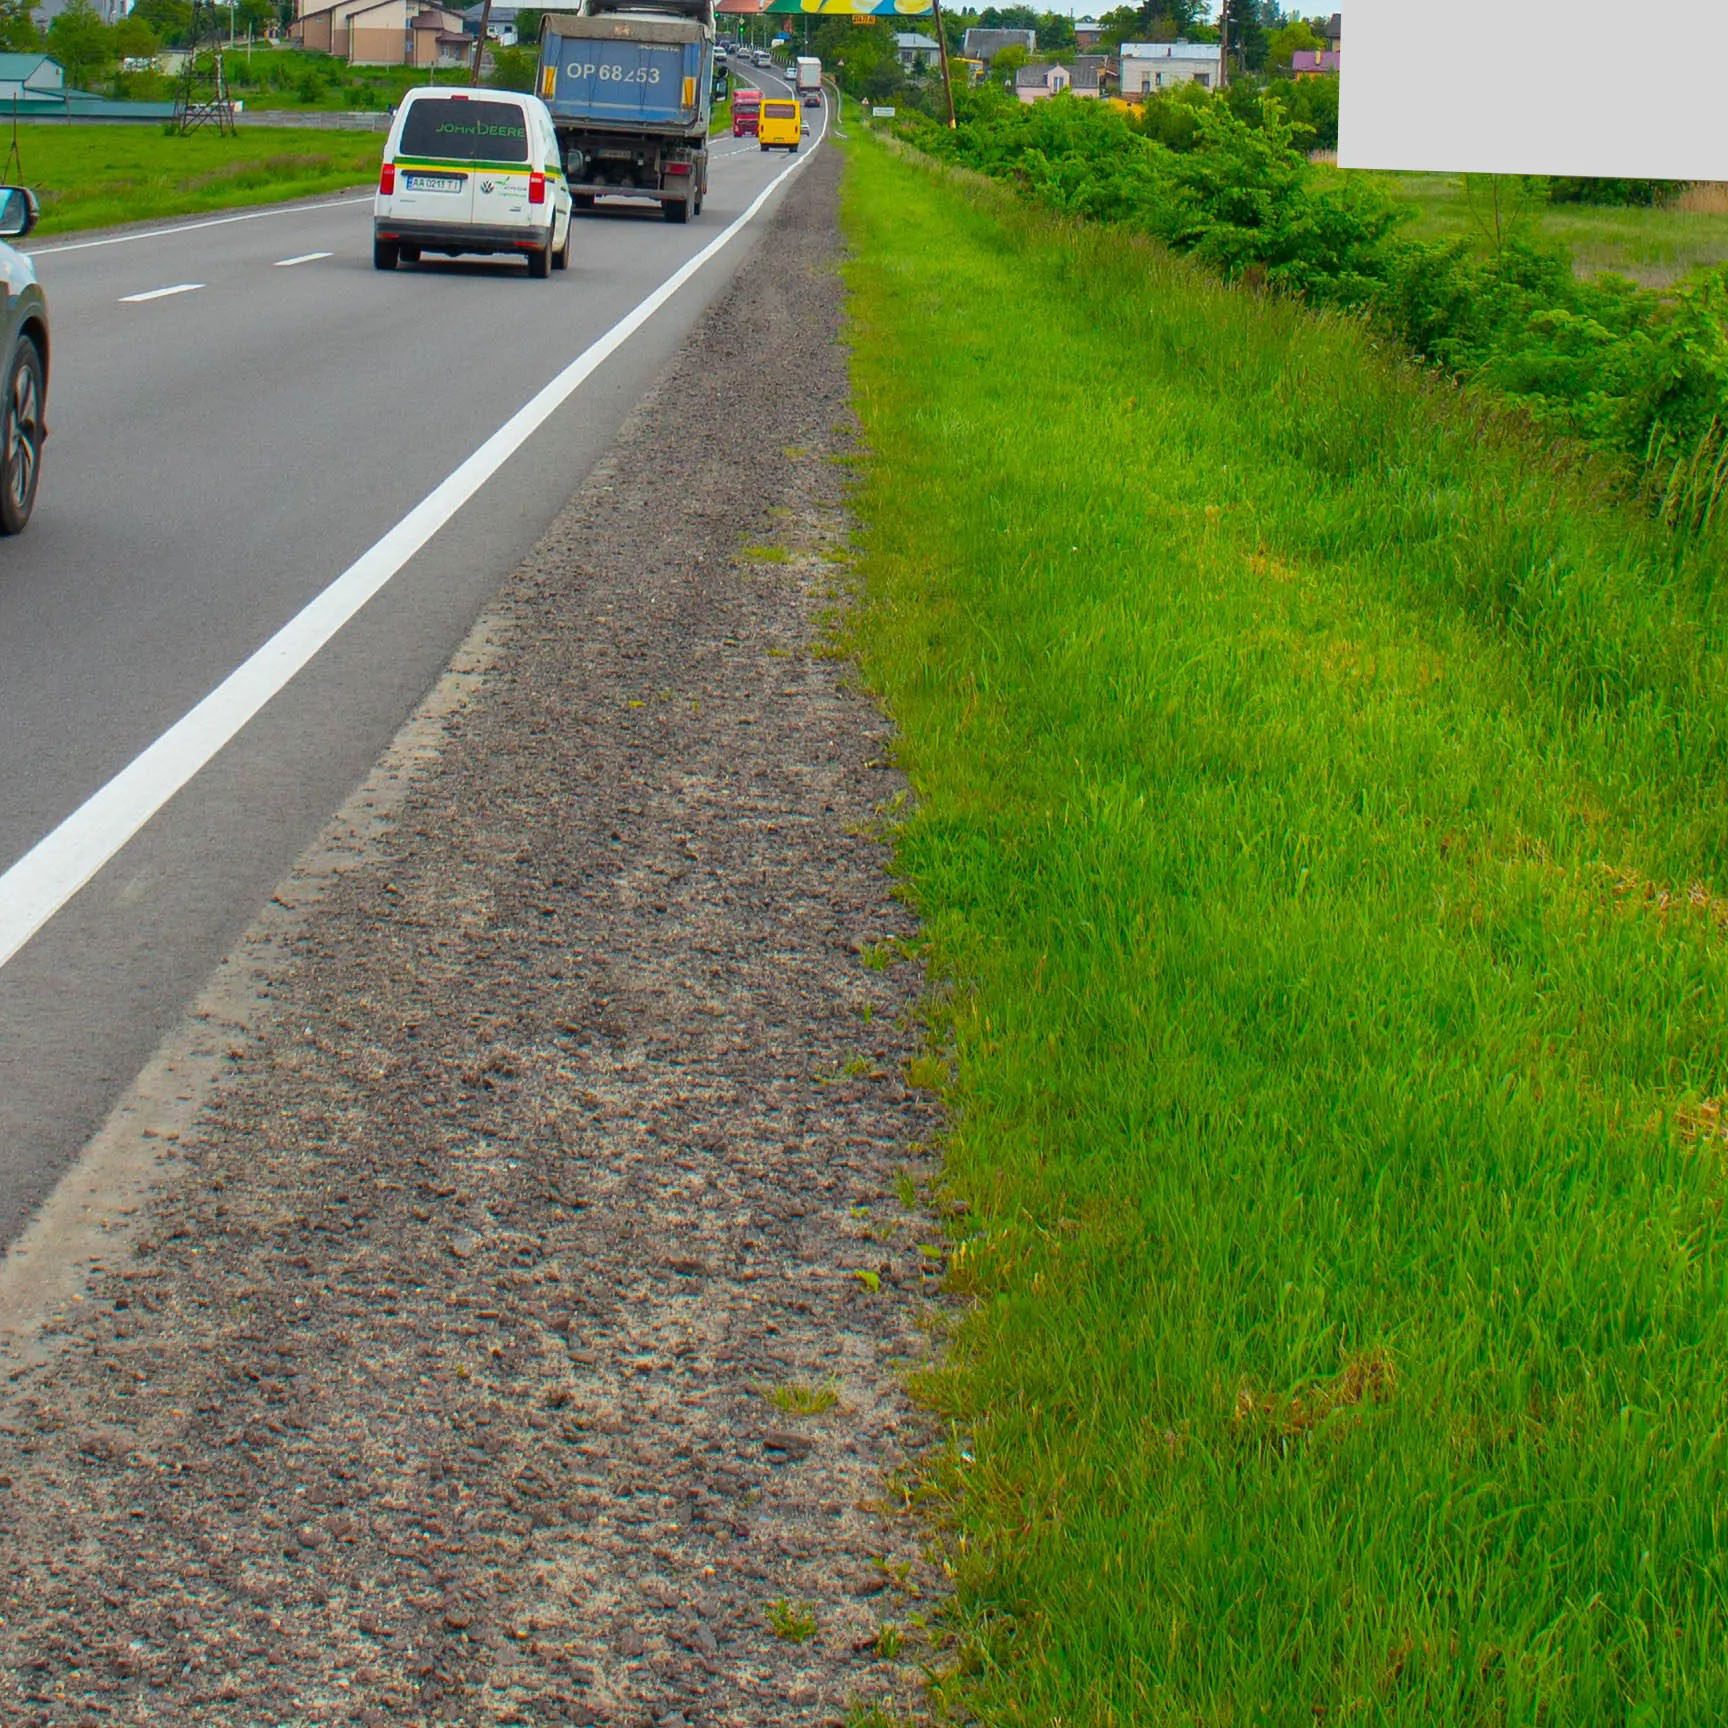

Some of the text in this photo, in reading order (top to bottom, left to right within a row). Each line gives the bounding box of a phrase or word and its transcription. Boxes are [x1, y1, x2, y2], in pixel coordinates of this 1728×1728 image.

[566, 62, 595, 80] OP
[435, 119, 525, 138] JOHN DEERE
